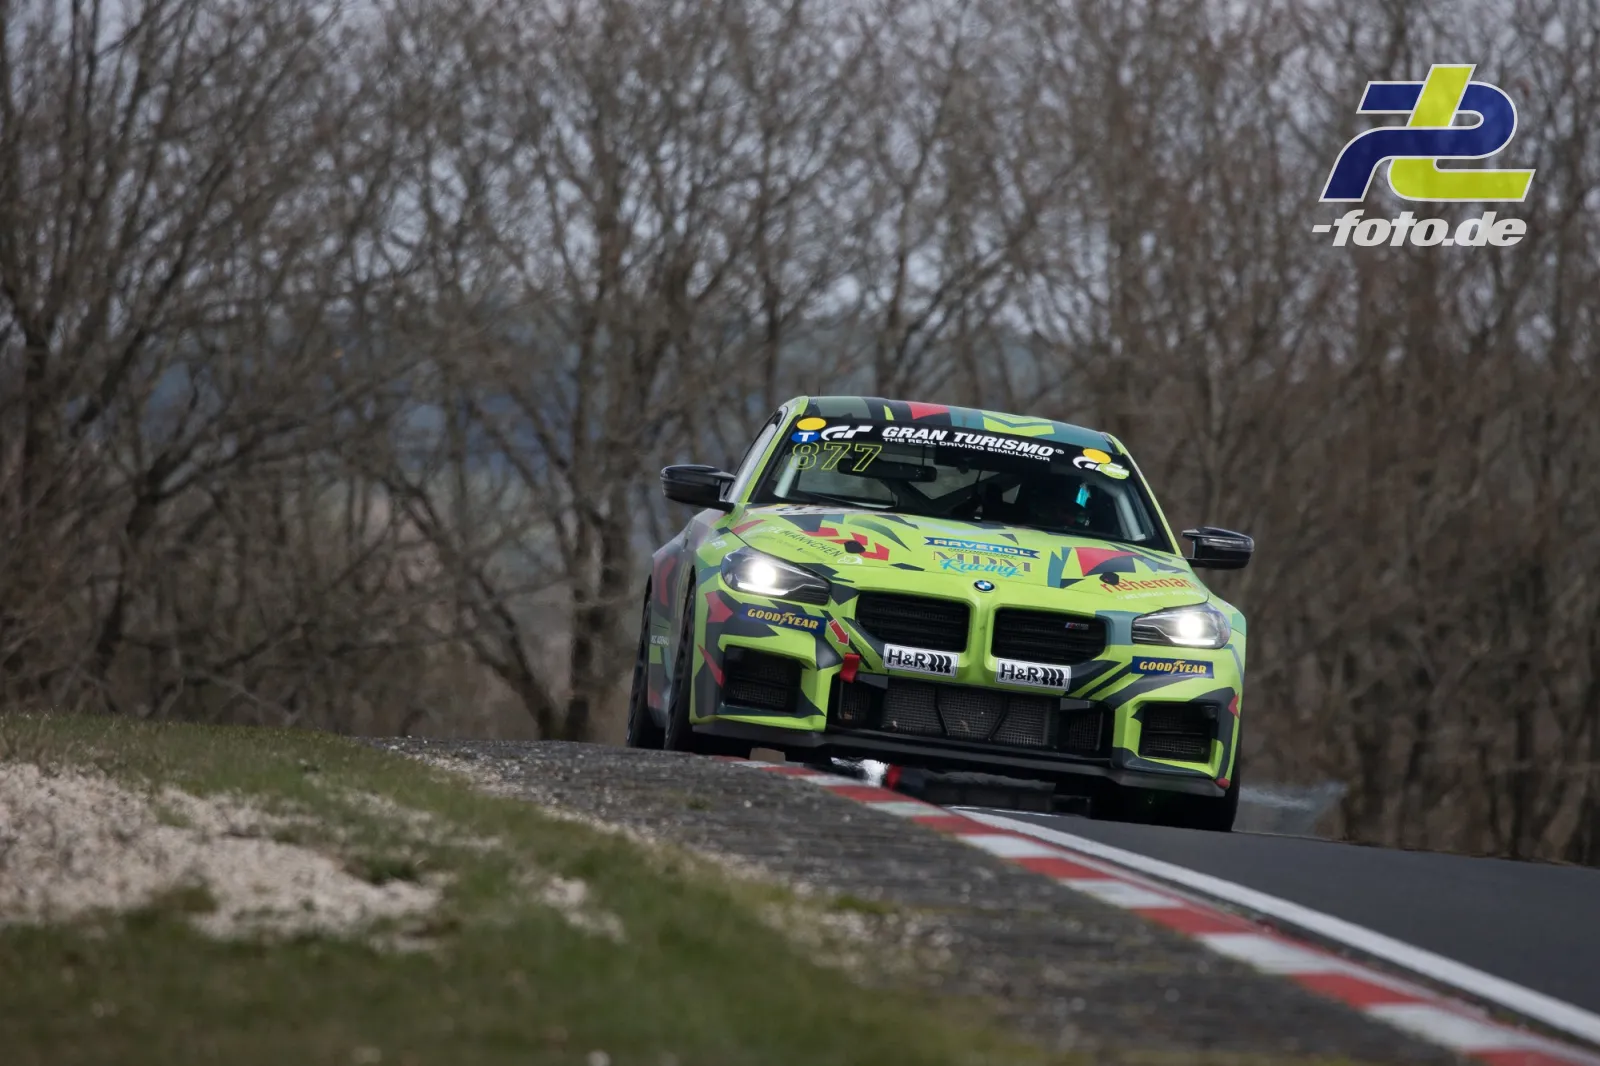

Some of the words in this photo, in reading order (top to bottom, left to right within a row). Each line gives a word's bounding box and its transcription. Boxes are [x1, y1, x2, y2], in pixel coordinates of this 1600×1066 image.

[881, 426, 948, 440] GRAN
[789, 441, 883, 472] 877
[940, 441, 984, 451] DRIVING
[987, 447, 1050, 462] SIMULATOR
[932, 539, 1032, 557] RAVENOL
[940, 558, 1024, 578] Racing
[747, 608, 819, 630] GOODYEAR
[887, 648, 927, 669] H&R
[1139, 660, 1207, 675] GOODYEAR
[1000, 663, 1039, 682] H&R
